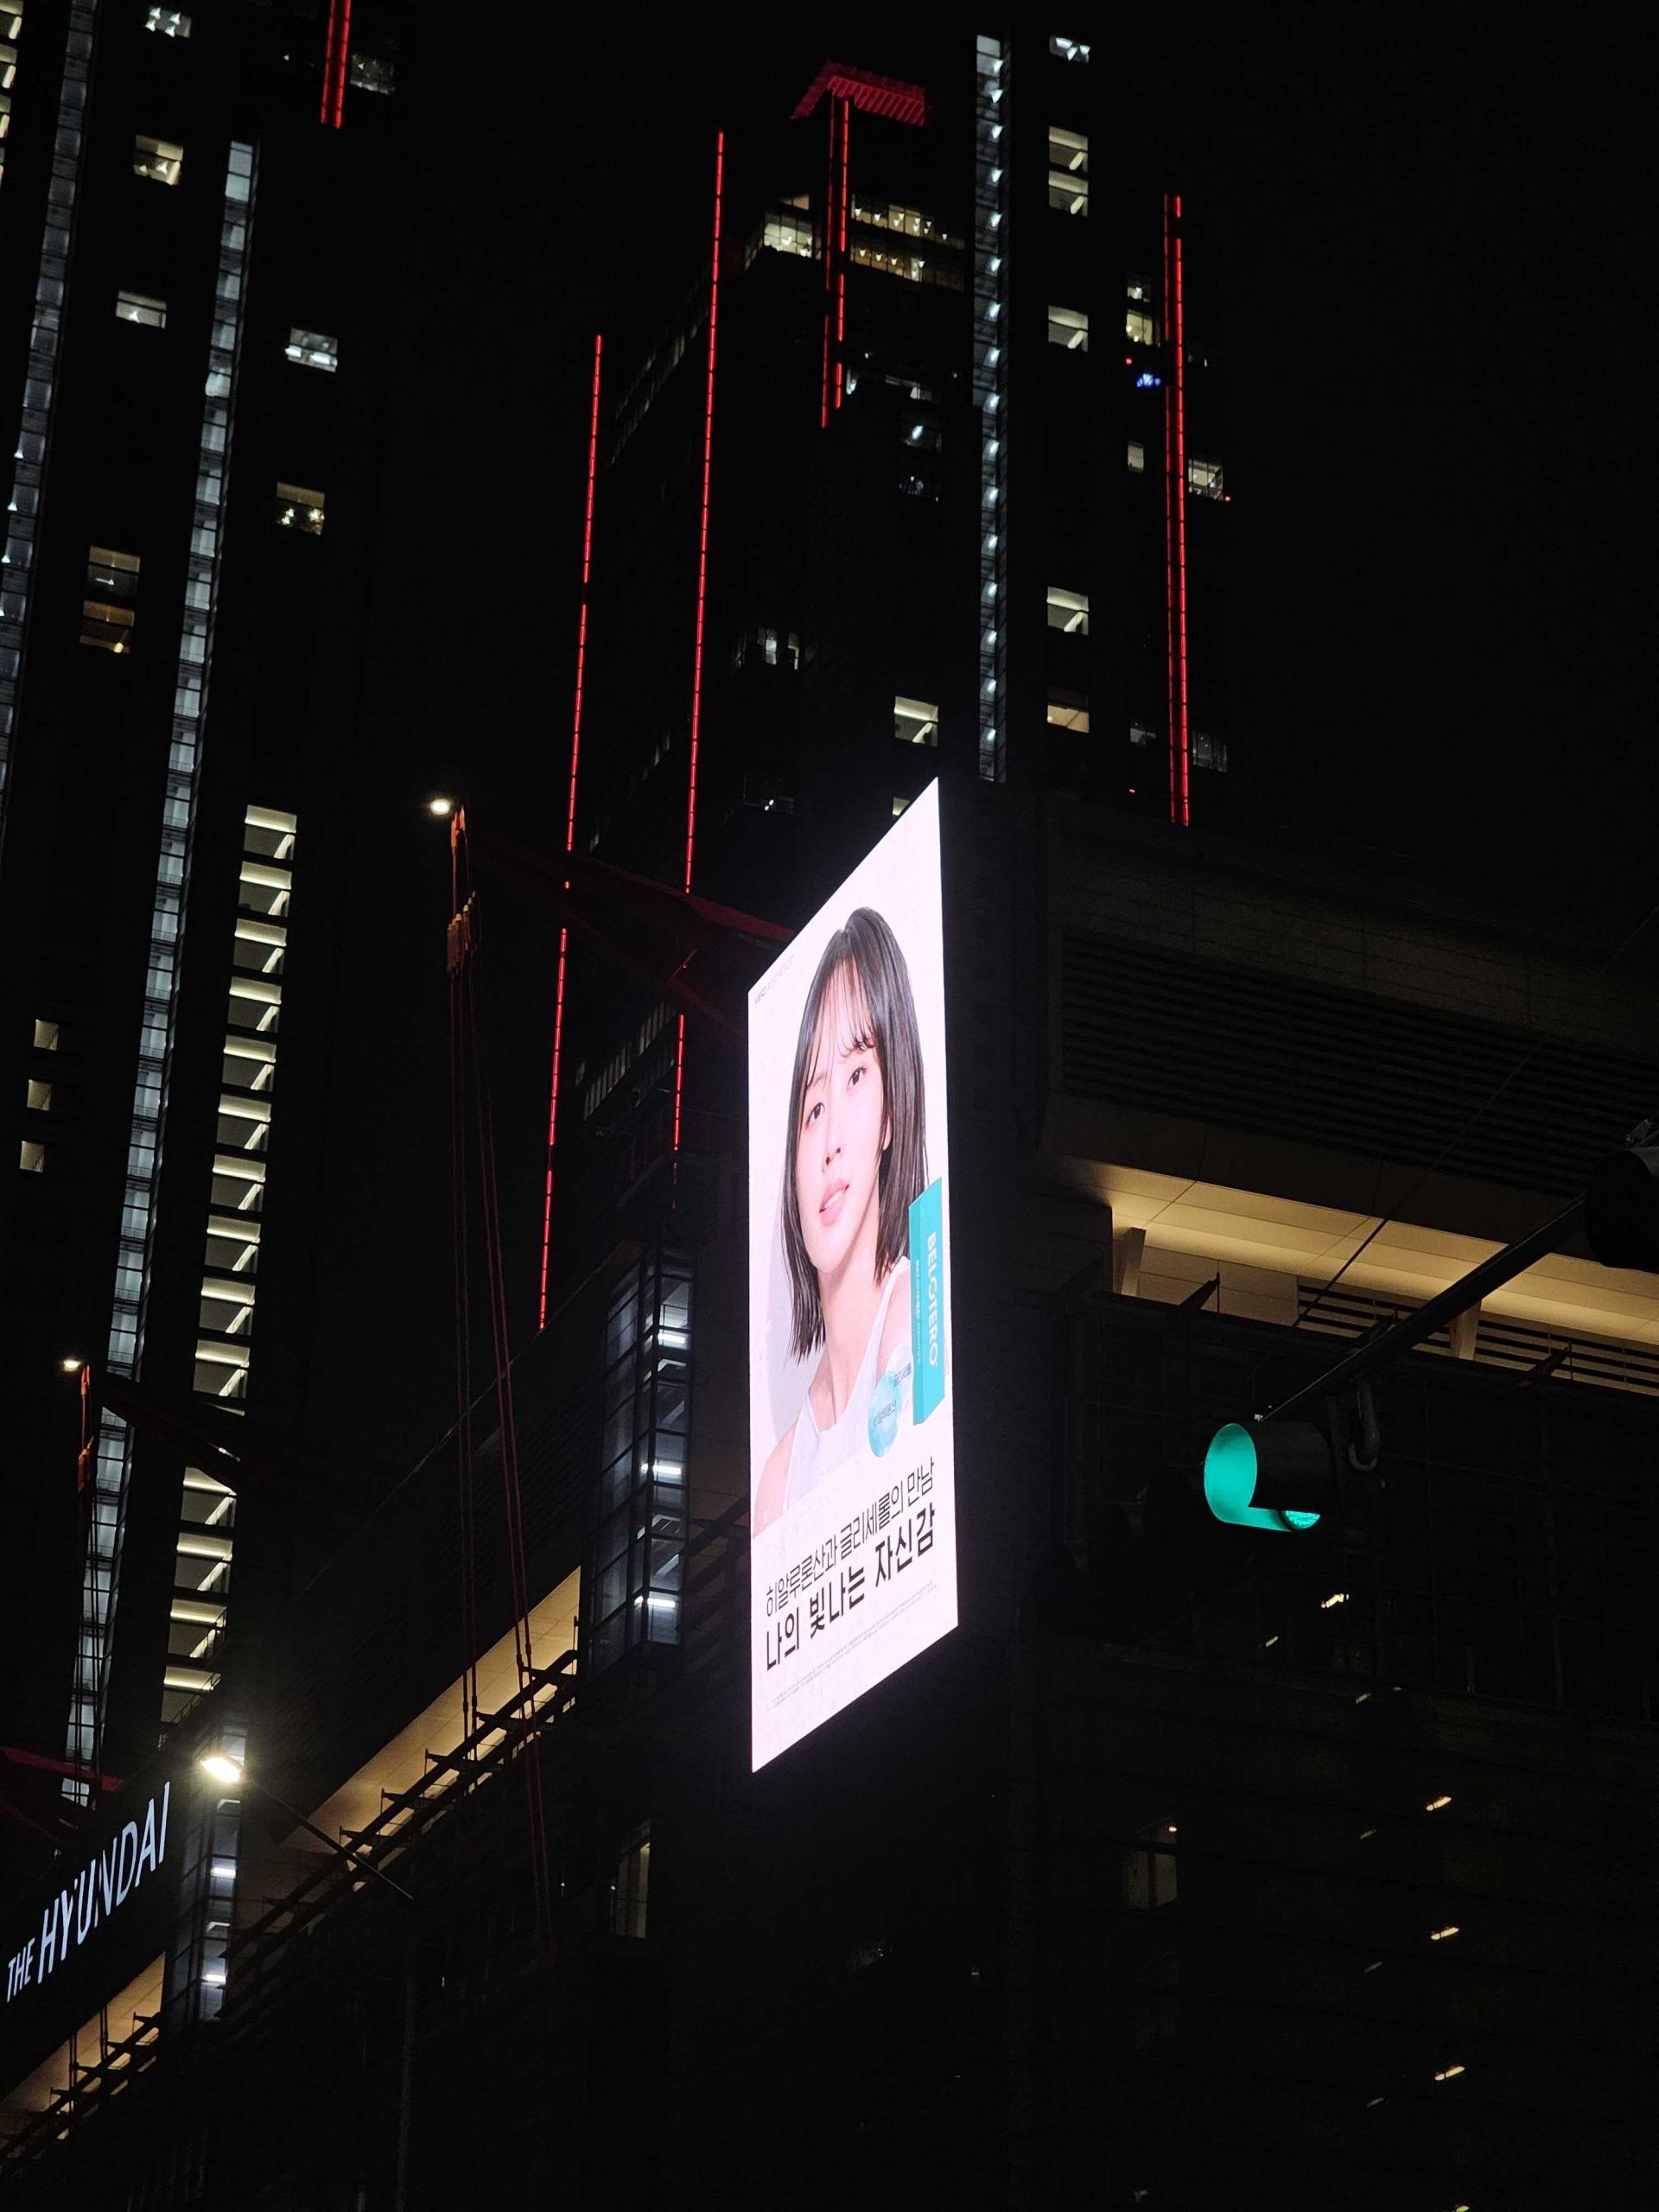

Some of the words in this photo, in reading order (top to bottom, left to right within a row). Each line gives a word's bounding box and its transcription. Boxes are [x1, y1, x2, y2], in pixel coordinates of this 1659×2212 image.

[927, 1230, 938, 1367] BELOTERO
[766, 1535, 838, 1618] 히알루론산과
[839, 1480, 905, 1560] 글리세롤의
[906, 1456, 935, 1505] 만남
[766, 1605, 800, 1672] 나의
[810, 1565, 865, 1640] 빛나는
[874, 1502, 935, 1588] 자신감
[6, 1937, 35, 2003] THE
[37, 1781, 170, 1985] HYUNDAI
